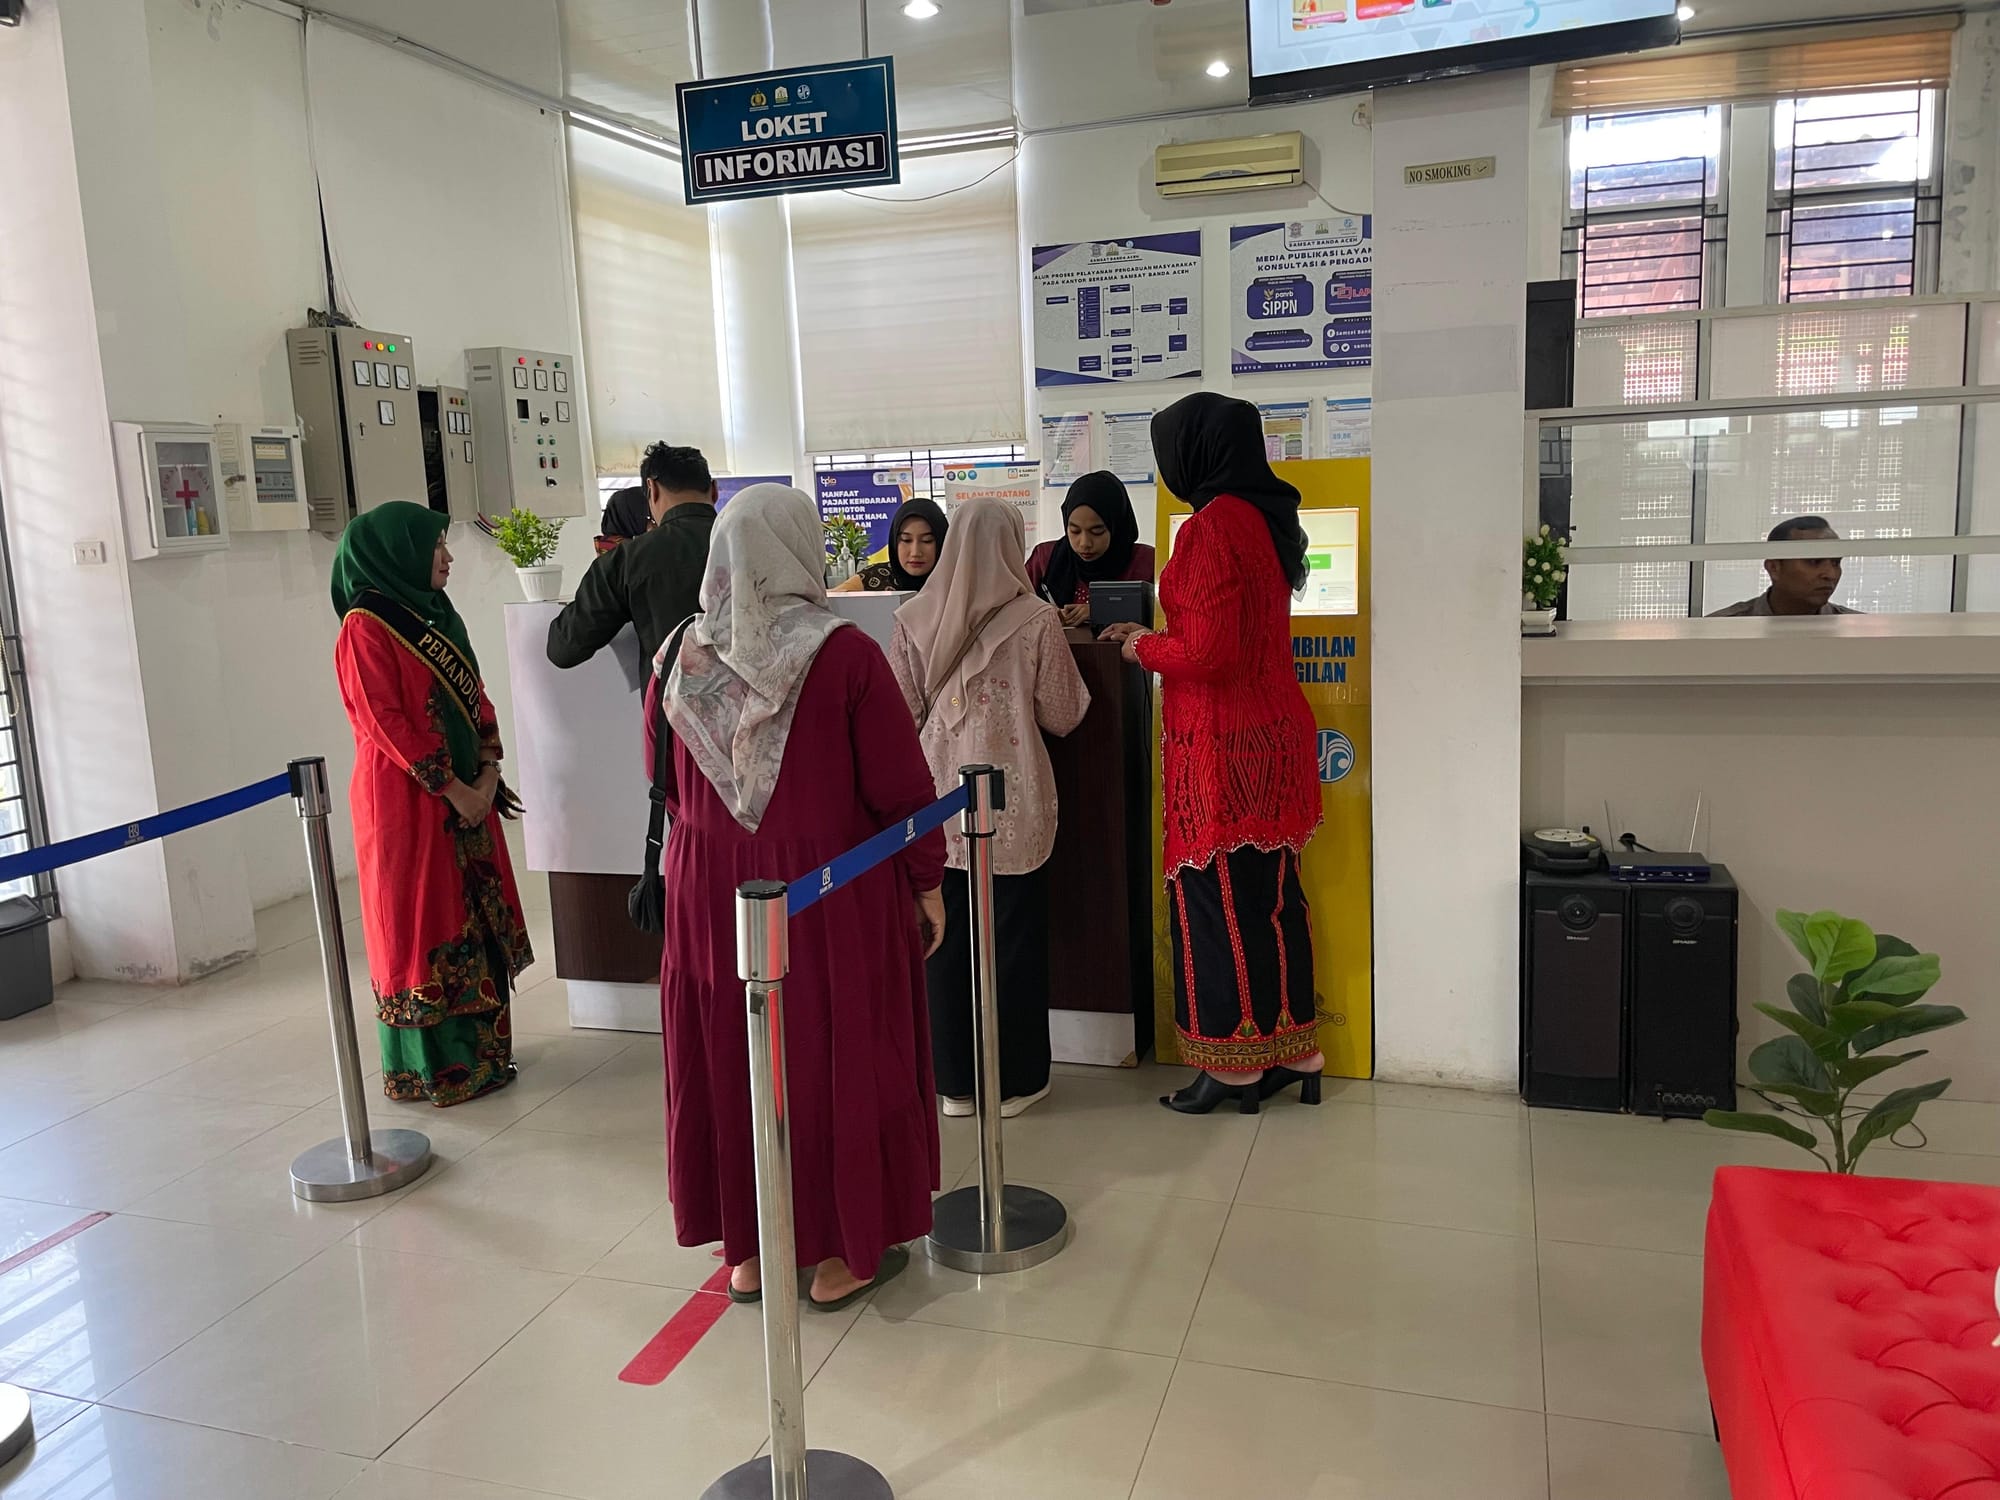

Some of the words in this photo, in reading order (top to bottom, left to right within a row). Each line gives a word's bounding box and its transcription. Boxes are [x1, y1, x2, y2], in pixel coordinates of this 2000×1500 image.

[742, 112, 827, 142] LOKET
[704, 141, 876, 183] INFORMASI
[1409, 170, 1422, 184] NO
[1425, 164, 1470, 181] SMOKING
[1256, 254, 1286, 262] MEDIA
[1288, 250, 1338, 260] PUBLIKASI
[1258, 261, 1318, 271] KONSULTASI
[1262, 300, 1297, 315] SIPPN
[955, 491, 994, 500] SELAMAT
[996, 490, 1030, 498] DATANG
[418, 632, 478, 705] PEMANDU
